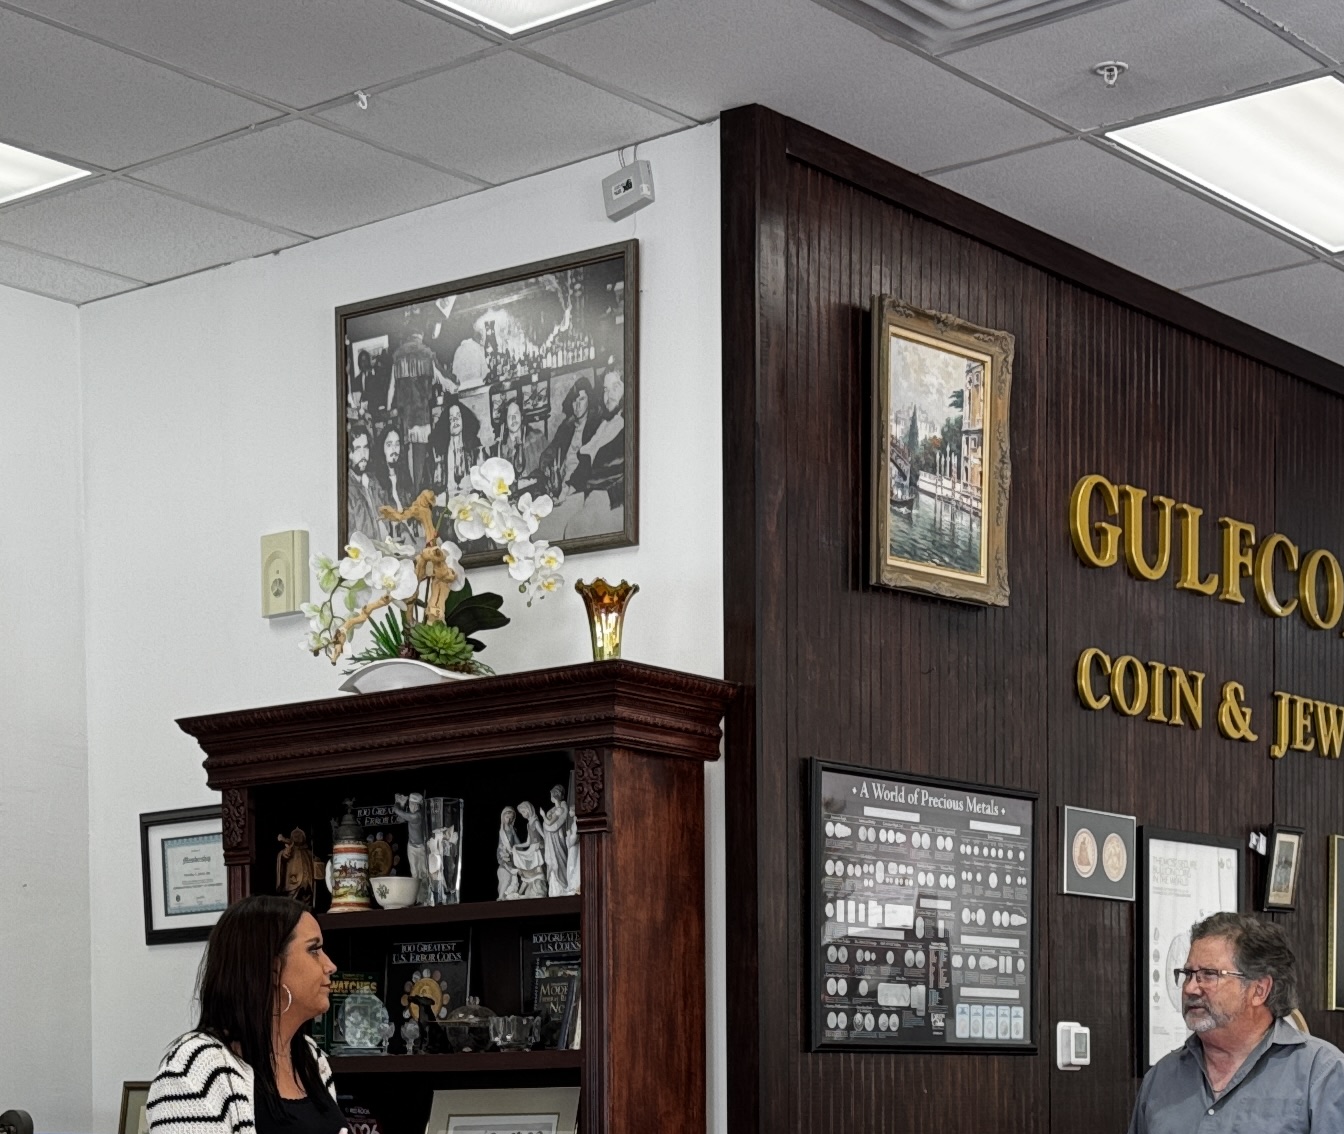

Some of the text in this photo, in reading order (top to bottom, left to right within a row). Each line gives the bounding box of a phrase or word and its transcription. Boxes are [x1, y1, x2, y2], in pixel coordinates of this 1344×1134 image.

[1076, 647, 1205, 730] COIN
[1217, 681, 1258, 742] &
[859, 781, 999, 817] A World of Precious Metals
[547, 932, 581, 942] GREATE
